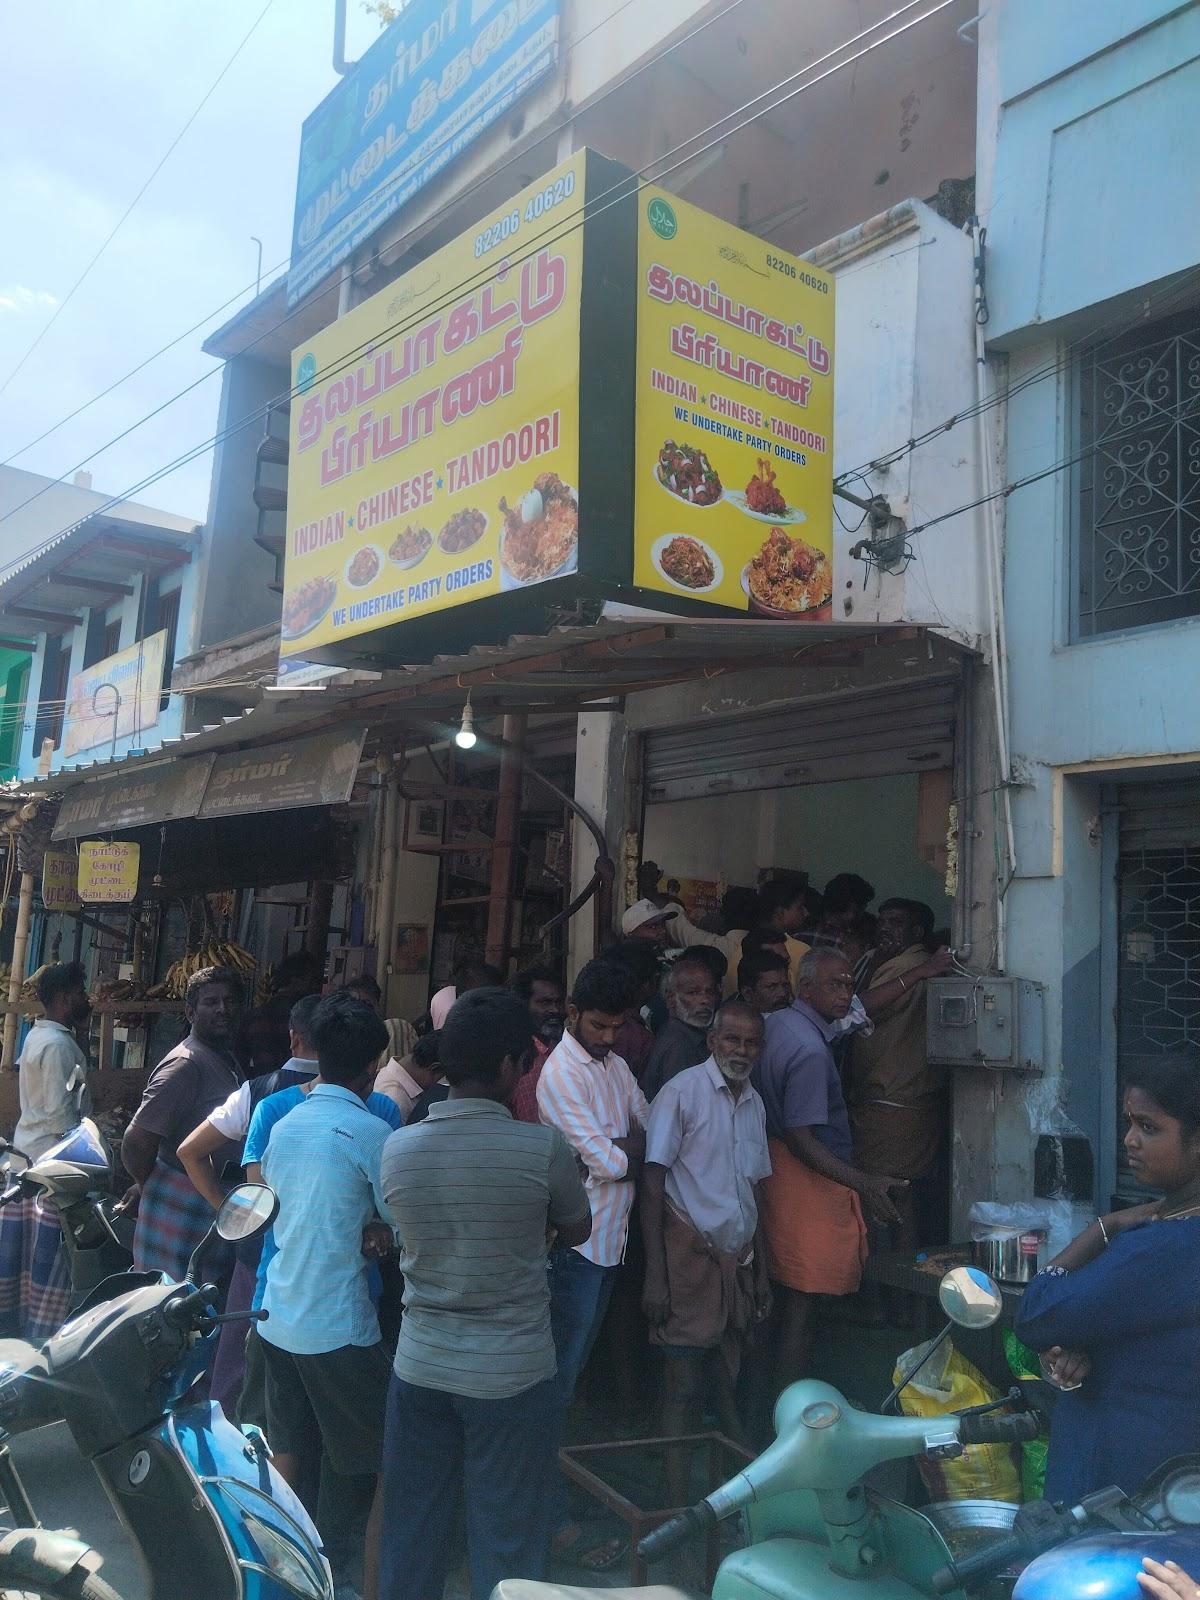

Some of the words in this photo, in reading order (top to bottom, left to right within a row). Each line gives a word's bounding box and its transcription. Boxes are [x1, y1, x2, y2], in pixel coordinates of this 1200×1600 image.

[474, 208, 520, 258] 82206
[523, 171, 575, 223] 40620
[766, 253, 797, 279] 82206
[799, 272, 829, 295] 40620
[297, 250, 566, 454] தலப்பாகட்டு
[647, 263, 831, 375] தலப்பாகட்டு
[320, 326, 524, 488] பிரியாணி
[670, 322, 812, 408] பிரியாணி
[651, 367, 698, 404] INDIAN
[708, 390, 762, 429] CHINESE
[770, 415, 826, 454] TANDOORI
[674, 405, 689, 422] WE
[692, 413, 743, 443] UNDERTAKE
[746, 432, 772, 454] PARTY
[775, 445, 807, 466] ORDERS
[293, 510, 345, 557] INDIAN
[355, 466, 434, 532] CHINESE
[446, 409, 561, 495] TANDOORI
[332, 606, 346, 626] WE
[349, 590, 404, 623] UNDERTAKE
[407, 576, 443, 605] PARTY
[445, 559, 493, 594] ORDERS
